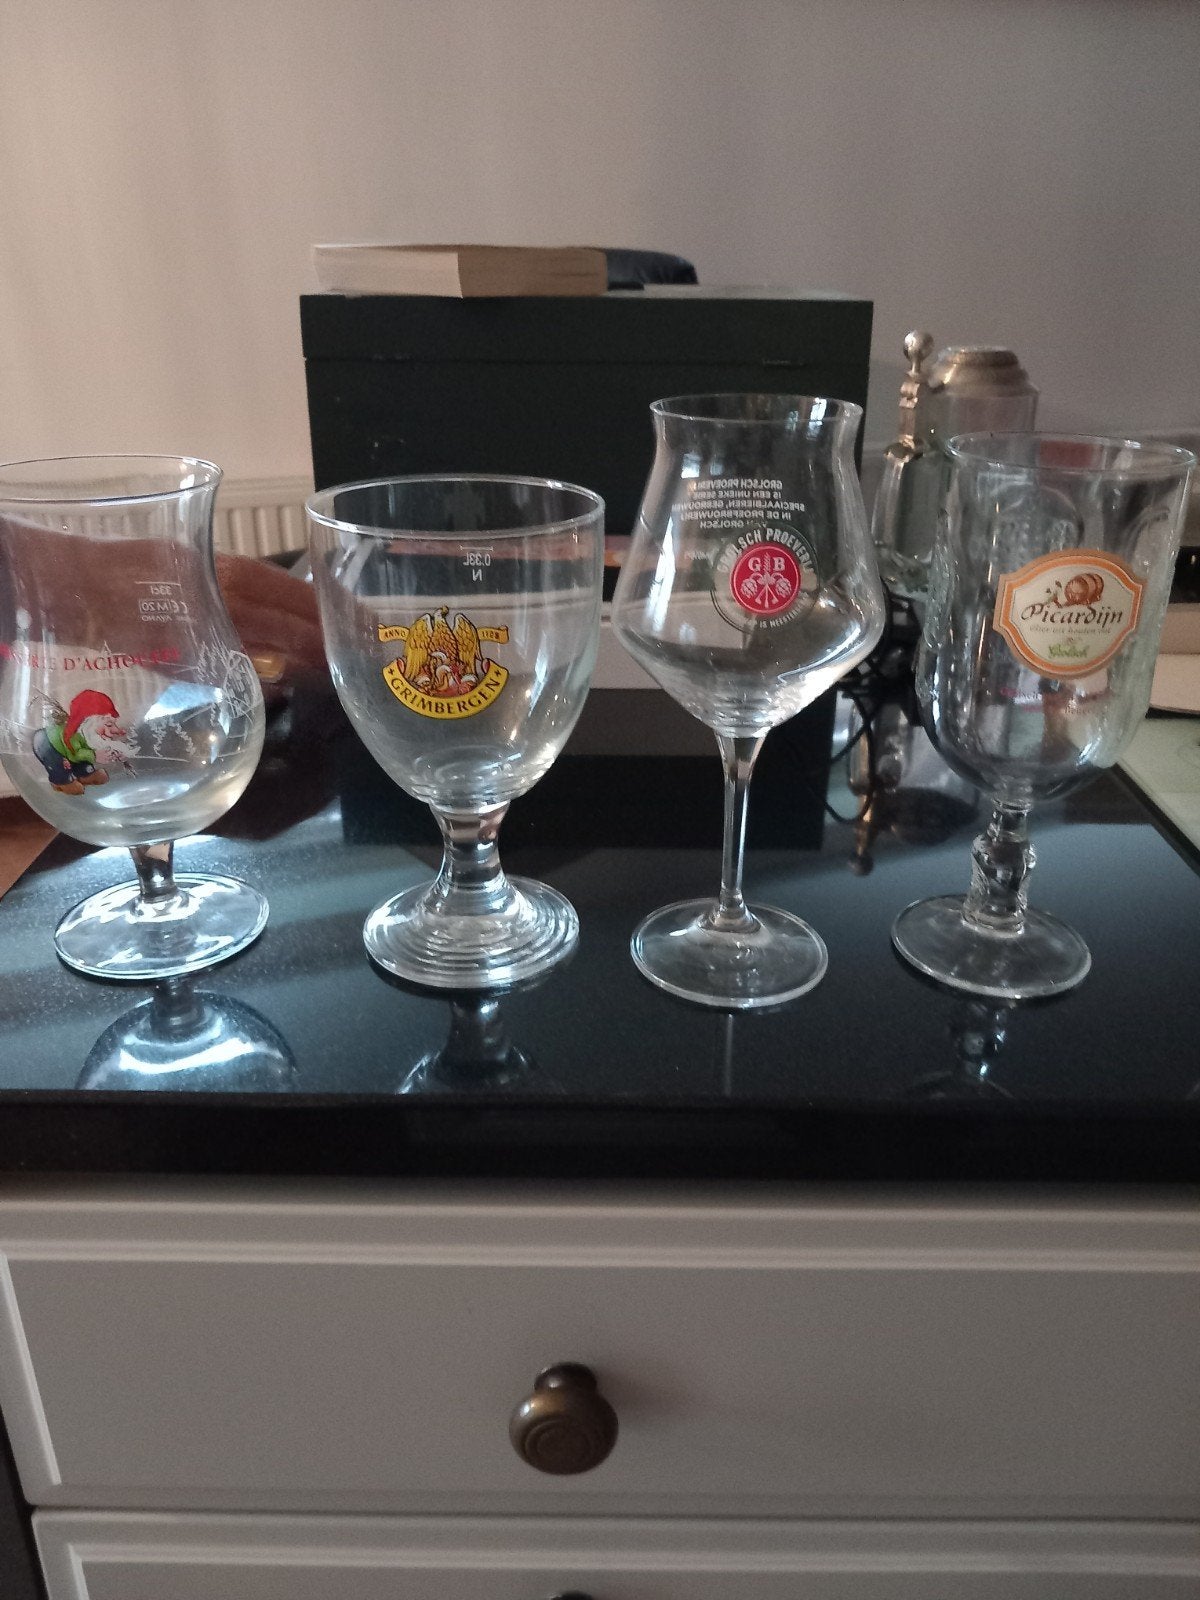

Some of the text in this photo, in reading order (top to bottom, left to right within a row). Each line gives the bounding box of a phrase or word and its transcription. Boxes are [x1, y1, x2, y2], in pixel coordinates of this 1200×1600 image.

[748, 556, 786, 572] G B
[1020, 601, 1124, 629] Picardijn
[391, 677, 502, 715] GRIMBERGEN
